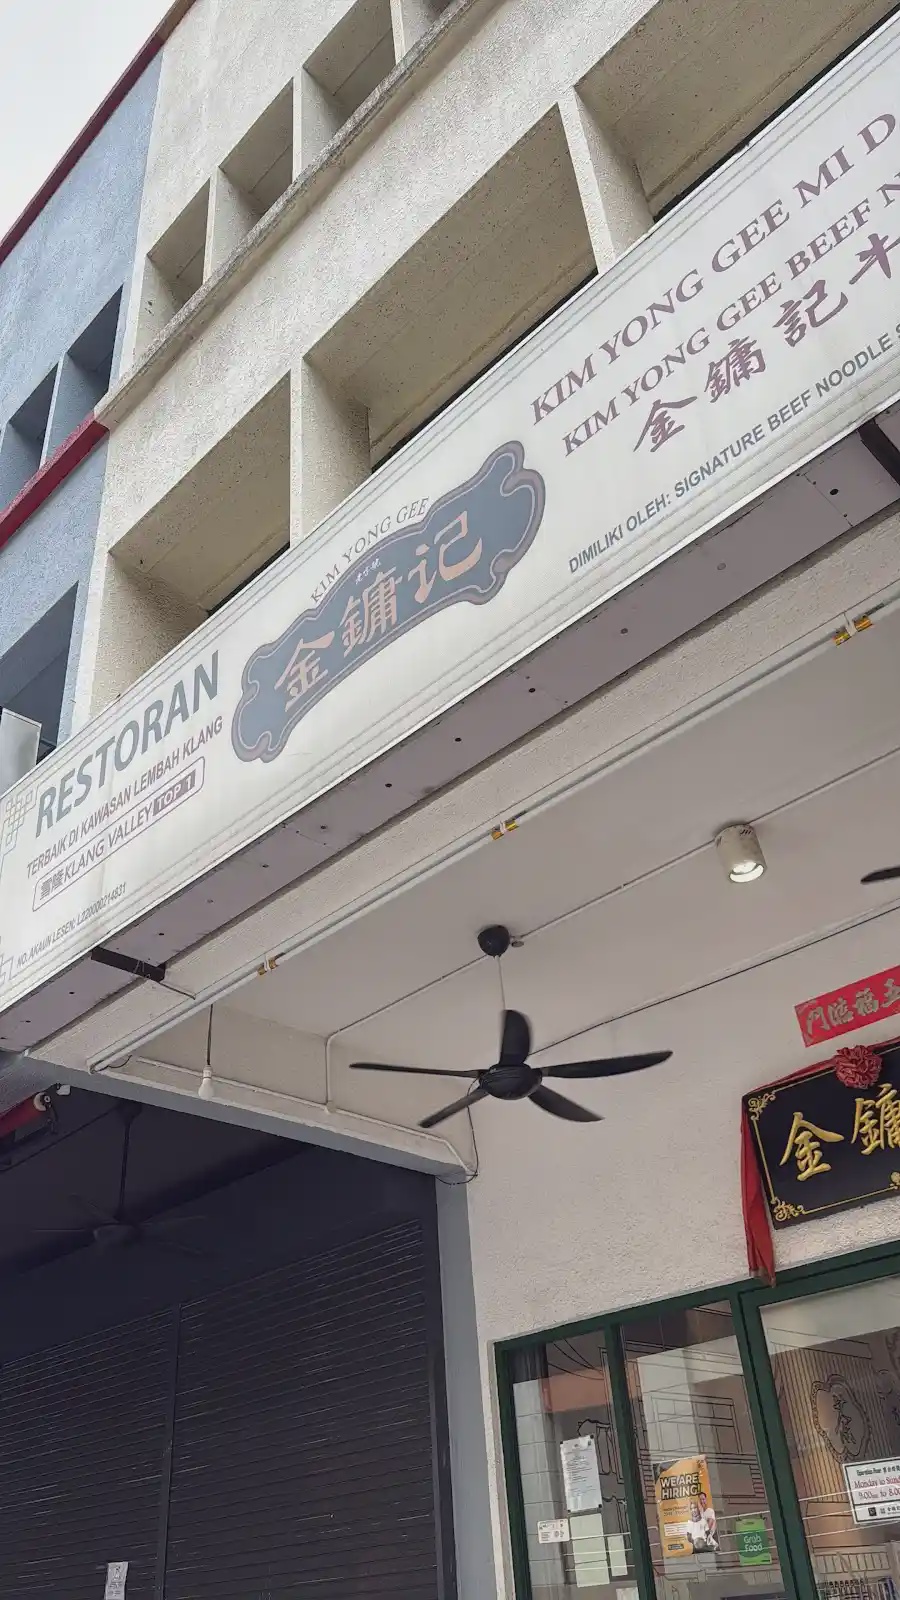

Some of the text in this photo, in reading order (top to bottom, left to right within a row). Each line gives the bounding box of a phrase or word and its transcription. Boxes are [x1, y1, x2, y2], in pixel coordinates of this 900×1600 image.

[530, 113, 900, 426] KIM YONG GEE MI D
[562, 396, 621, 457] KIM
[620, 327, 711, 407] YONG
[716, 271, 782, 331] GEE
[785, 198, 871, 281] BEEF
[568, 332, 894, 574] DIMILIKI OLEH: SIGNATURE BEEF NOODLE
[311, 496, 430, 603] KIM YONG GEE
[27, 715, 223, 879] TERBAIK DI KAWASAN LEMBAH KLANG
[36, 650, 220, 838] RESTORAN
[63, 838, 105, 883] KLANG
[107, 802, 153, 848] VALLEY
[154, 783, 182, 812] TOP
[185, 774, 193, 792] 1
[661, 1474, 699, 1487] WE ARE
[661, 1484, 702, 1500] HIRING!
[854, 1479, 878, 1489] Monday
[743, 1534, 762, 1544] Grab
[744, 1543, 763, 1553] Food
